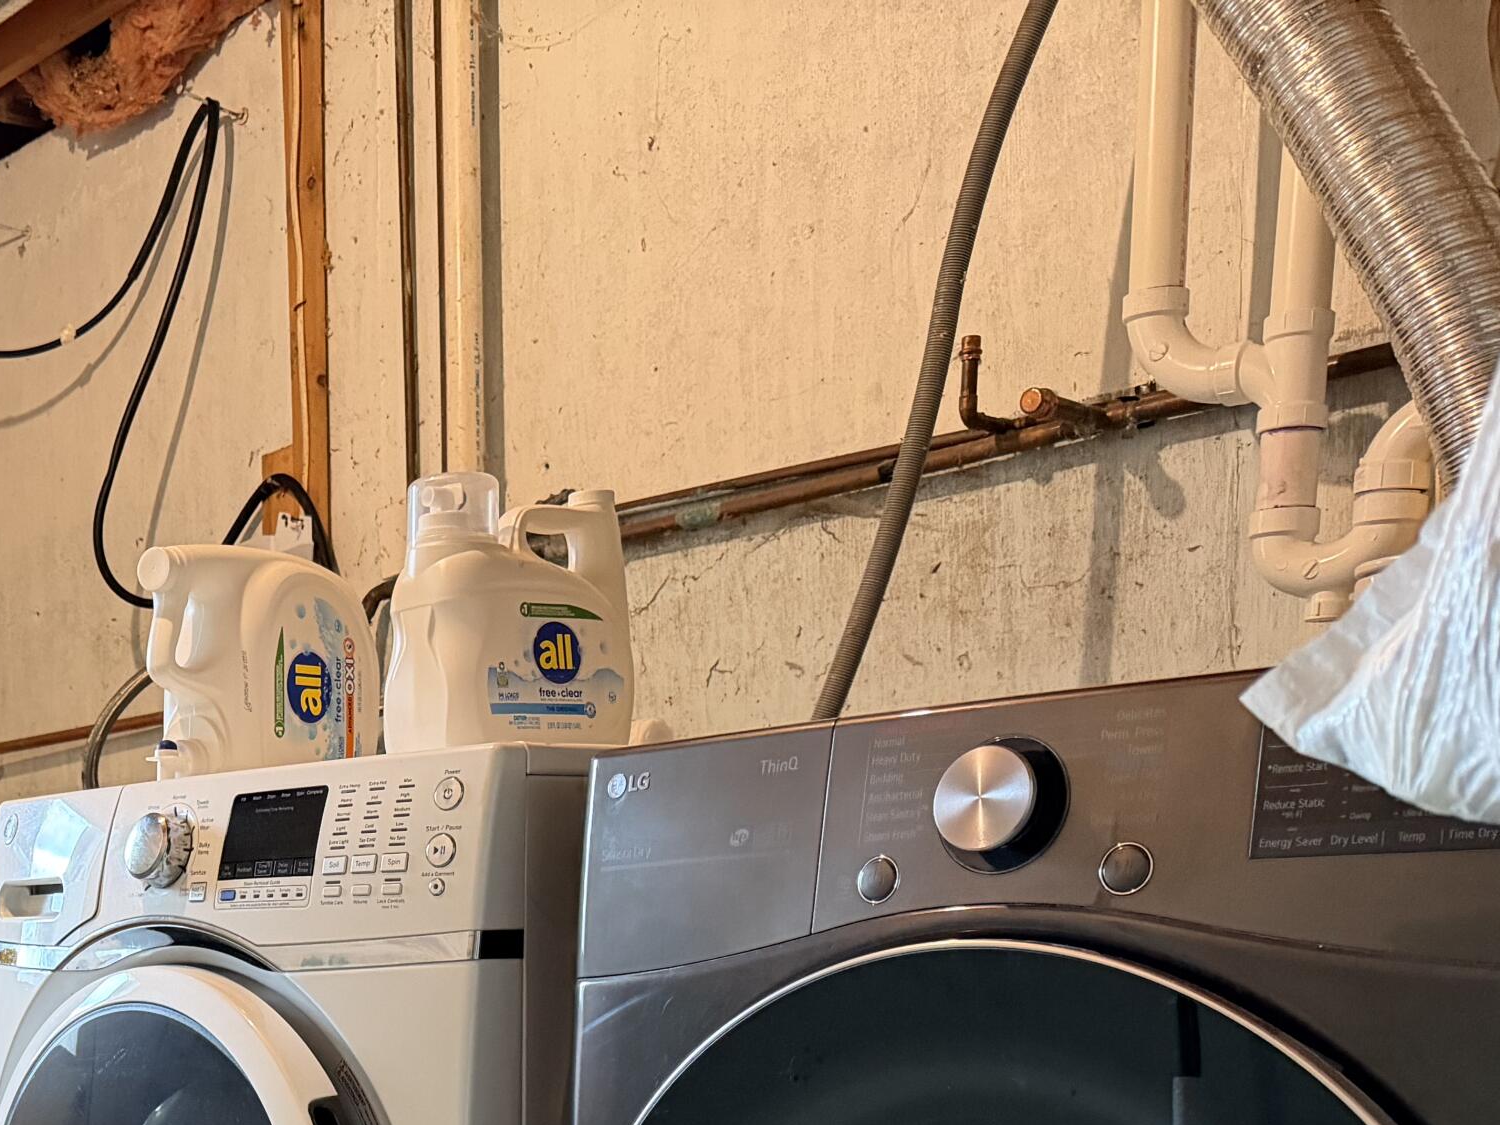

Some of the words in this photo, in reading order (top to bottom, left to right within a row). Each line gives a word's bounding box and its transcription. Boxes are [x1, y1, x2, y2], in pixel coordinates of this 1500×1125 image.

[540, 633, 574, 670] all
[334, 656, 343, 689] clear
[344, 657, 355, 695] OXI
[294, 663, 322, 717] all
[561, 687, 583, 698] clear
[334, 697, 342, 723] free
[760, 756, 799, 776] ThinQ
[628, 771, 650, 792] LG
[1263, 800, 1295, 811] Reduce
[1299, 799, 1325, 809] Static
[1331, 835, 1348, 848] Dry
[1352, 834, 1379, 845] Level
[1399, 831, 1426, 843] Temp
[1449, 829, 1475, 840] Time
[1259, 838, 1292, 850] Energy
[329, 861, 340, 869] Soil
[355, 860, 371, 868] Temp
[387, 858, 401, 867] Spin
